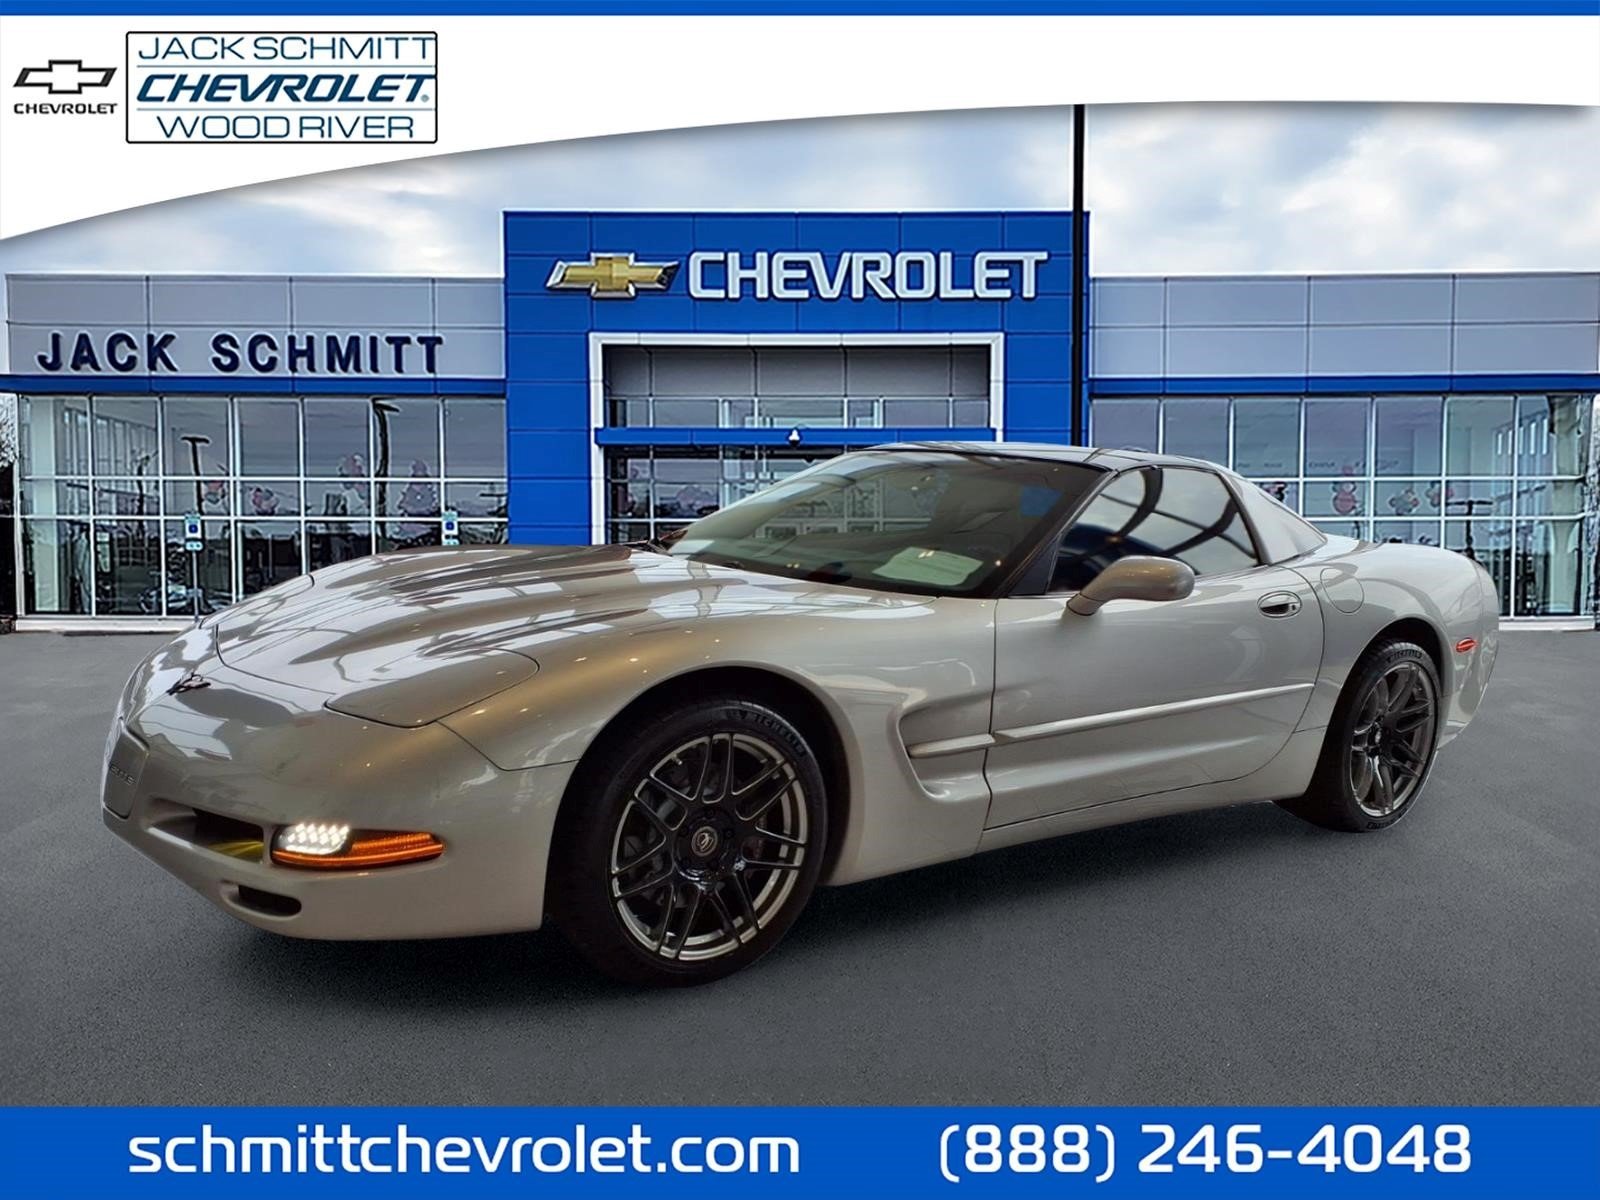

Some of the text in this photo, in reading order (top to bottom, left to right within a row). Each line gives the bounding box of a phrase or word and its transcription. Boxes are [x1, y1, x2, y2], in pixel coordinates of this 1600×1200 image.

[688, 251, 1048, 300] CHEVROLET
[37, 331, 443, 374] JACK SCHMITT
